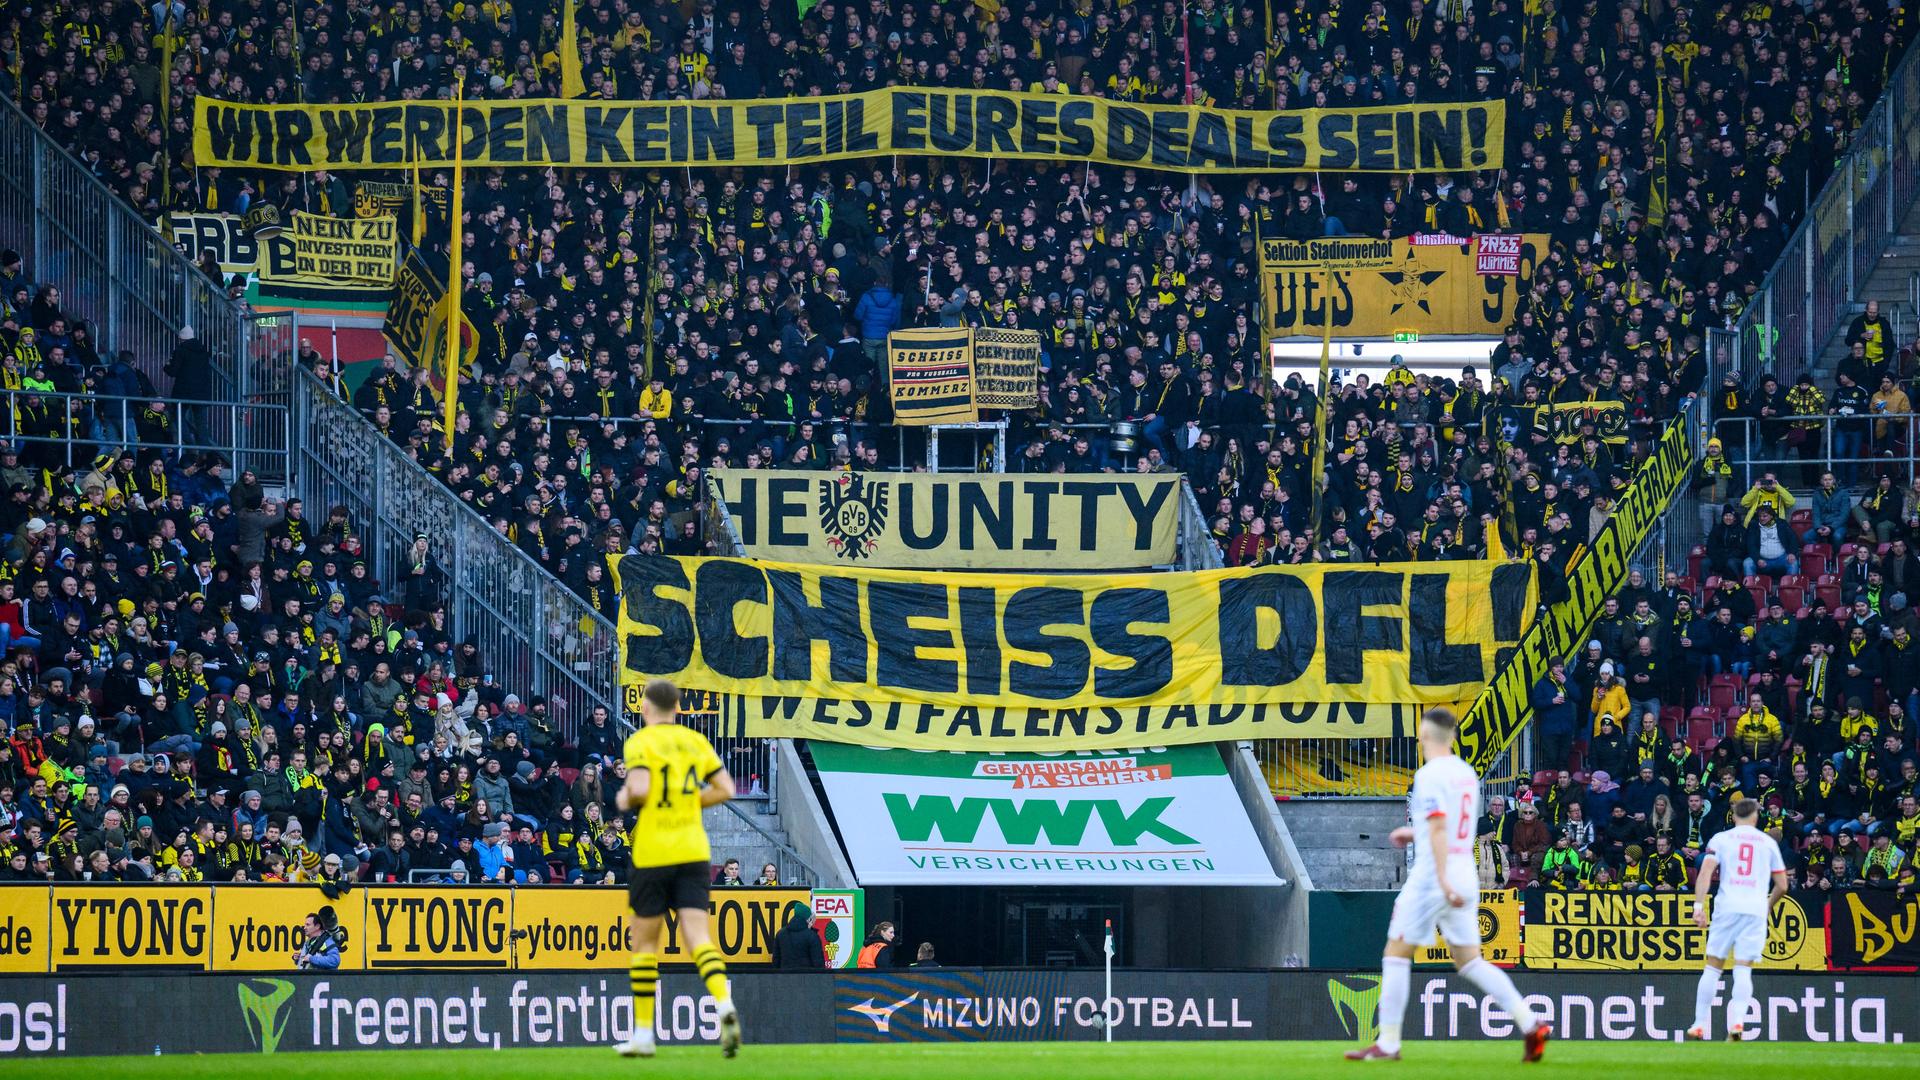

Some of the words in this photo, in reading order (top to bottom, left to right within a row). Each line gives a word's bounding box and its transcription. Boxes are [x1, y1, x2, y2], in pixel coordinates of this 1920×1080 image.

[207, 105, 313, 165] WIR
[319, 104, 571, 164] WERDEN
[584, 105, 735, 162] KEIN
[747, 98, 879, 159] TEIL
[890, 91, 1095, 156] EURES
[1107, 106, 1306, 169] DEALS
[1318, 107, 1488, 169] SEIN!
[296, 217, 355, 240] NEIN
[360, 220, 392, 241] ZU
[297, 239, 393, 259] INVESTOREN
[1263, 241, 1309, 261] Sektion
[1310, 239, 1393, 261] Stadionverbot
[1479, 235, 1520, 254] FREE
[297, 257, 316, 273] IN
[319, 259, 352, 276] DER
[355, 261, 392, 278] DFL!
[897, 350, 964, 363] SCHEISS
[976, 345, 1037, 361] SEKTION
[976, 362, 1037, 377] STADION
[894, 382, 969, 397] KOMMERZ
[976, 378, 1036, 393] VERBOT
[842, 504, 866, 527] BVB
[898, 480, 1178, 551] UNITY
[848, 525, 858, 534] 09
[617, 553, 1173, 700] SCHEISS
[1217, 562, 1532, 687] DFL!
[761, 695, 1367, 738] WESTFALENSTADION
[982, 759, 1133, 776] GEMEINSAM?
[1020, 774, 1050, 789] JA
[1055, 768, 1161, 787] SICHER!
[881, 792, 1202, 847] WWK
[907, 854, 1216, 872] VERSICHERUNGEN
[1737, 842, 1754, 877] 9
[815, 898, 849, 914] FCA
[56, 897, 207, 957] YTONG
[371, 897, 506, 954] YTONG
[1845, 891, 1920, 964] BU
[1493, 948, 1508, 961] 87
[1553, 927, 1711, 961] BORUSSE
[1769, 941, 1786, 955] 09
[922, 997, 1040, 1028] MIZUNO
[1053, 996, 1253, 1028] FOOTBALL
